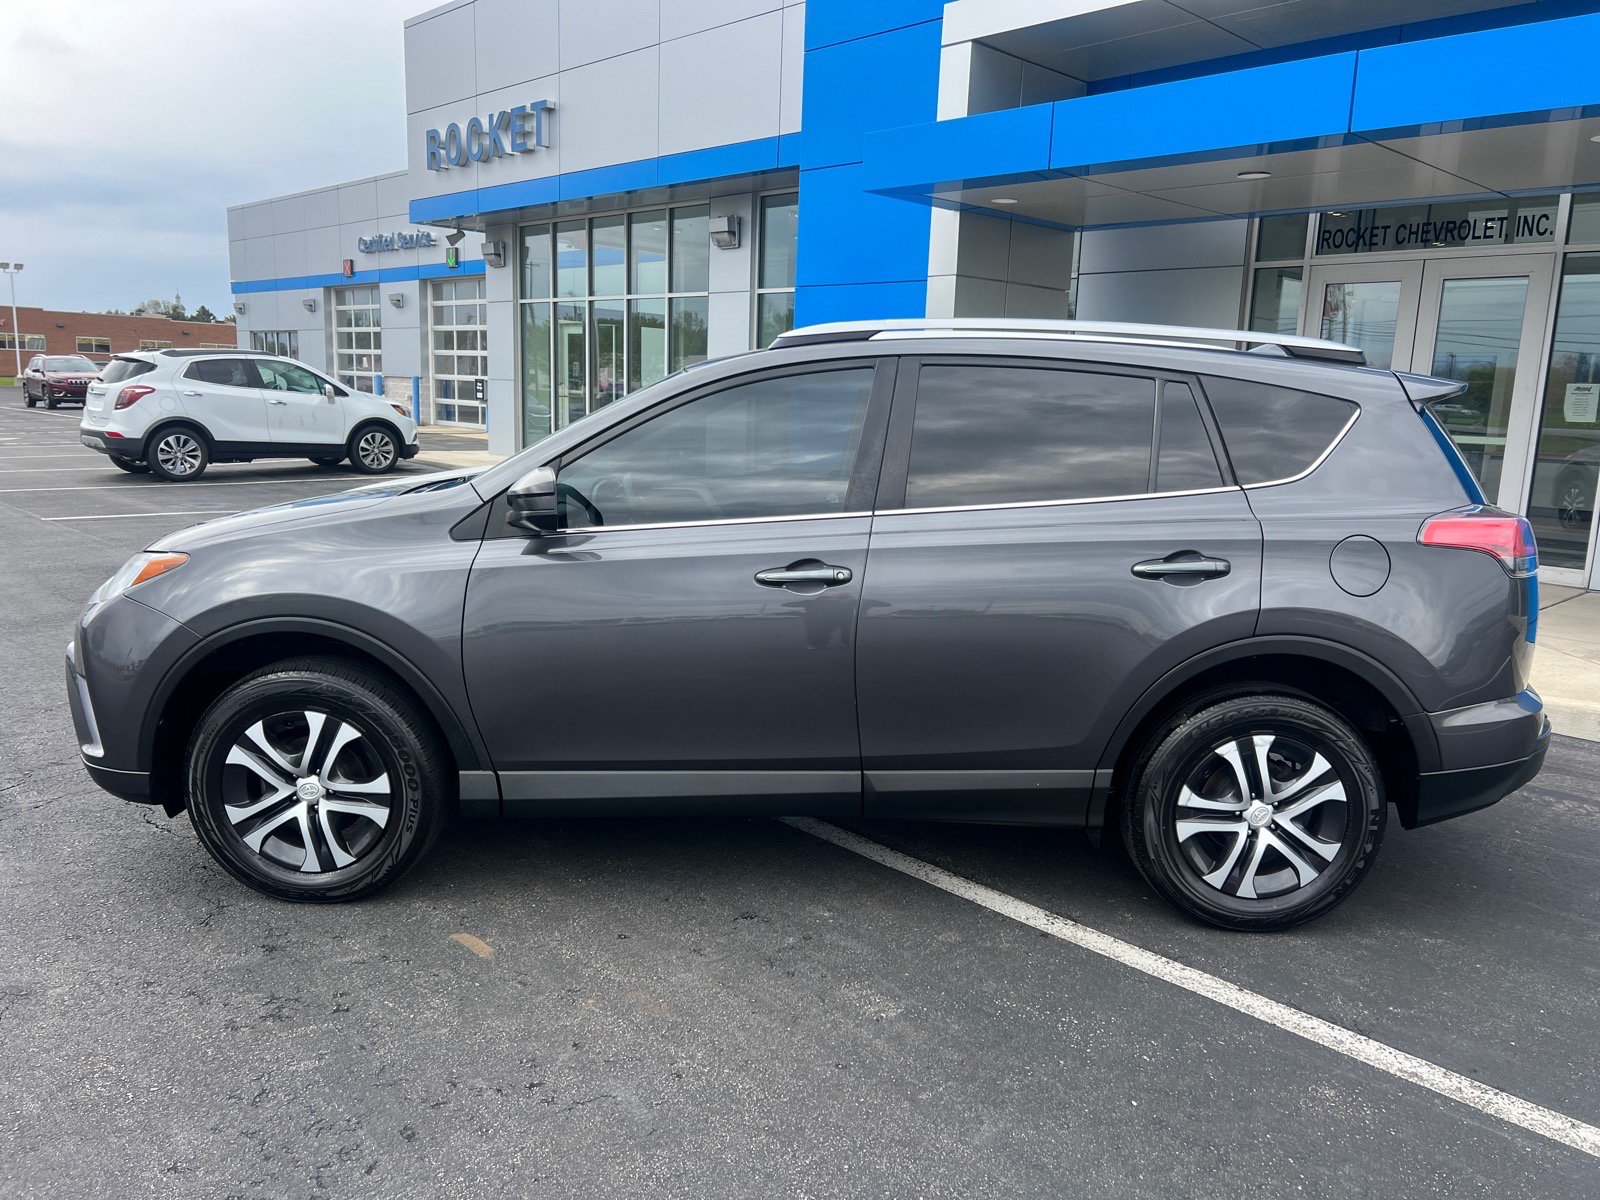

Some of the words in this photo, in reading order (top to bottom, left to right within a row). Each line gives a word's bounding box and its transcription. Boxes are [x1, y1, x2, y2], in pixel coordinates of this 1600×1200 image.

[425, 99, 554, 172] ROCKET
[357, 231, 397, 254] Certified
[1320, 224, 1391, 250] ROCKET
[1395, 216, 1508, 245] CHEVROLET,
[1516, 213, 1554, 238] INC.
